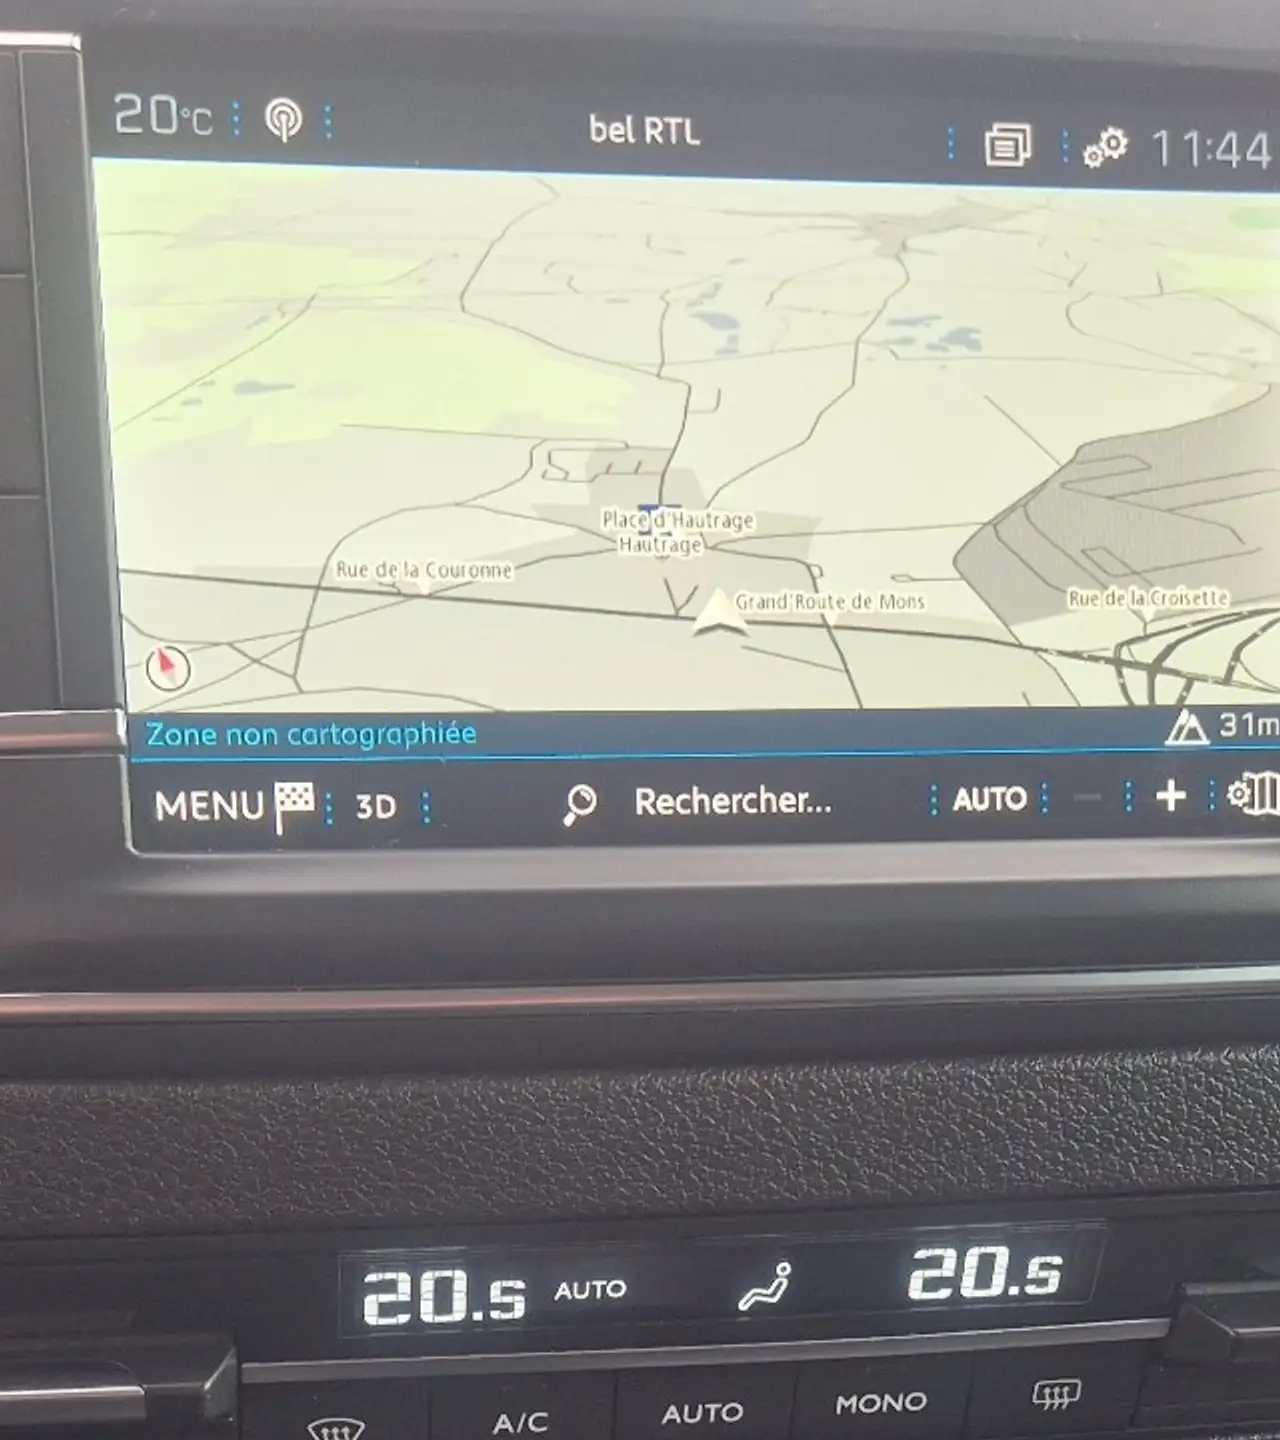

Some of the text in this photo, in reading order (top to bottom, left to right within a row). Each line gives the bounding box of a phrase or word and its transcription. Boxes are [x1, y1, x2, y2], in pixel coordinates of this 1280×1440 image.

[588, 113, 702, 146] bel RTL
[1152, 129, 1272, 170] 11:44
[603, 510, 754, 532] Place d'Hautrage
[620, 536, 702, 556] Hautrage
[337, 560, 512, 579] Rue de la Couronne
[852, 594, 873, 611] de
[879, 594, 926, 611] Mons
[1069, 590, 1228, 607] Rue de la Croisette
[147, 720, 477, 751] Zone non cartographiée
[1220, 712, 1280, 738] 31m
[155, 790, 265, 822] MENU
[356, 794, 397, 820] 3D
[635, 785, 832, 816] Rechercher...
[953, 786, 1028, 812] AUTO
[907, 1246, 1064, 1301] 20.5
[363, 1269, 526, 1326] 20.5
[554, 1279, 628, 1301] AUTO
[661, 1402, 744, 1426] AUTO
[835, 1391, 928, 1415] MONO
[492, 1411, 550, 1435] A/C
